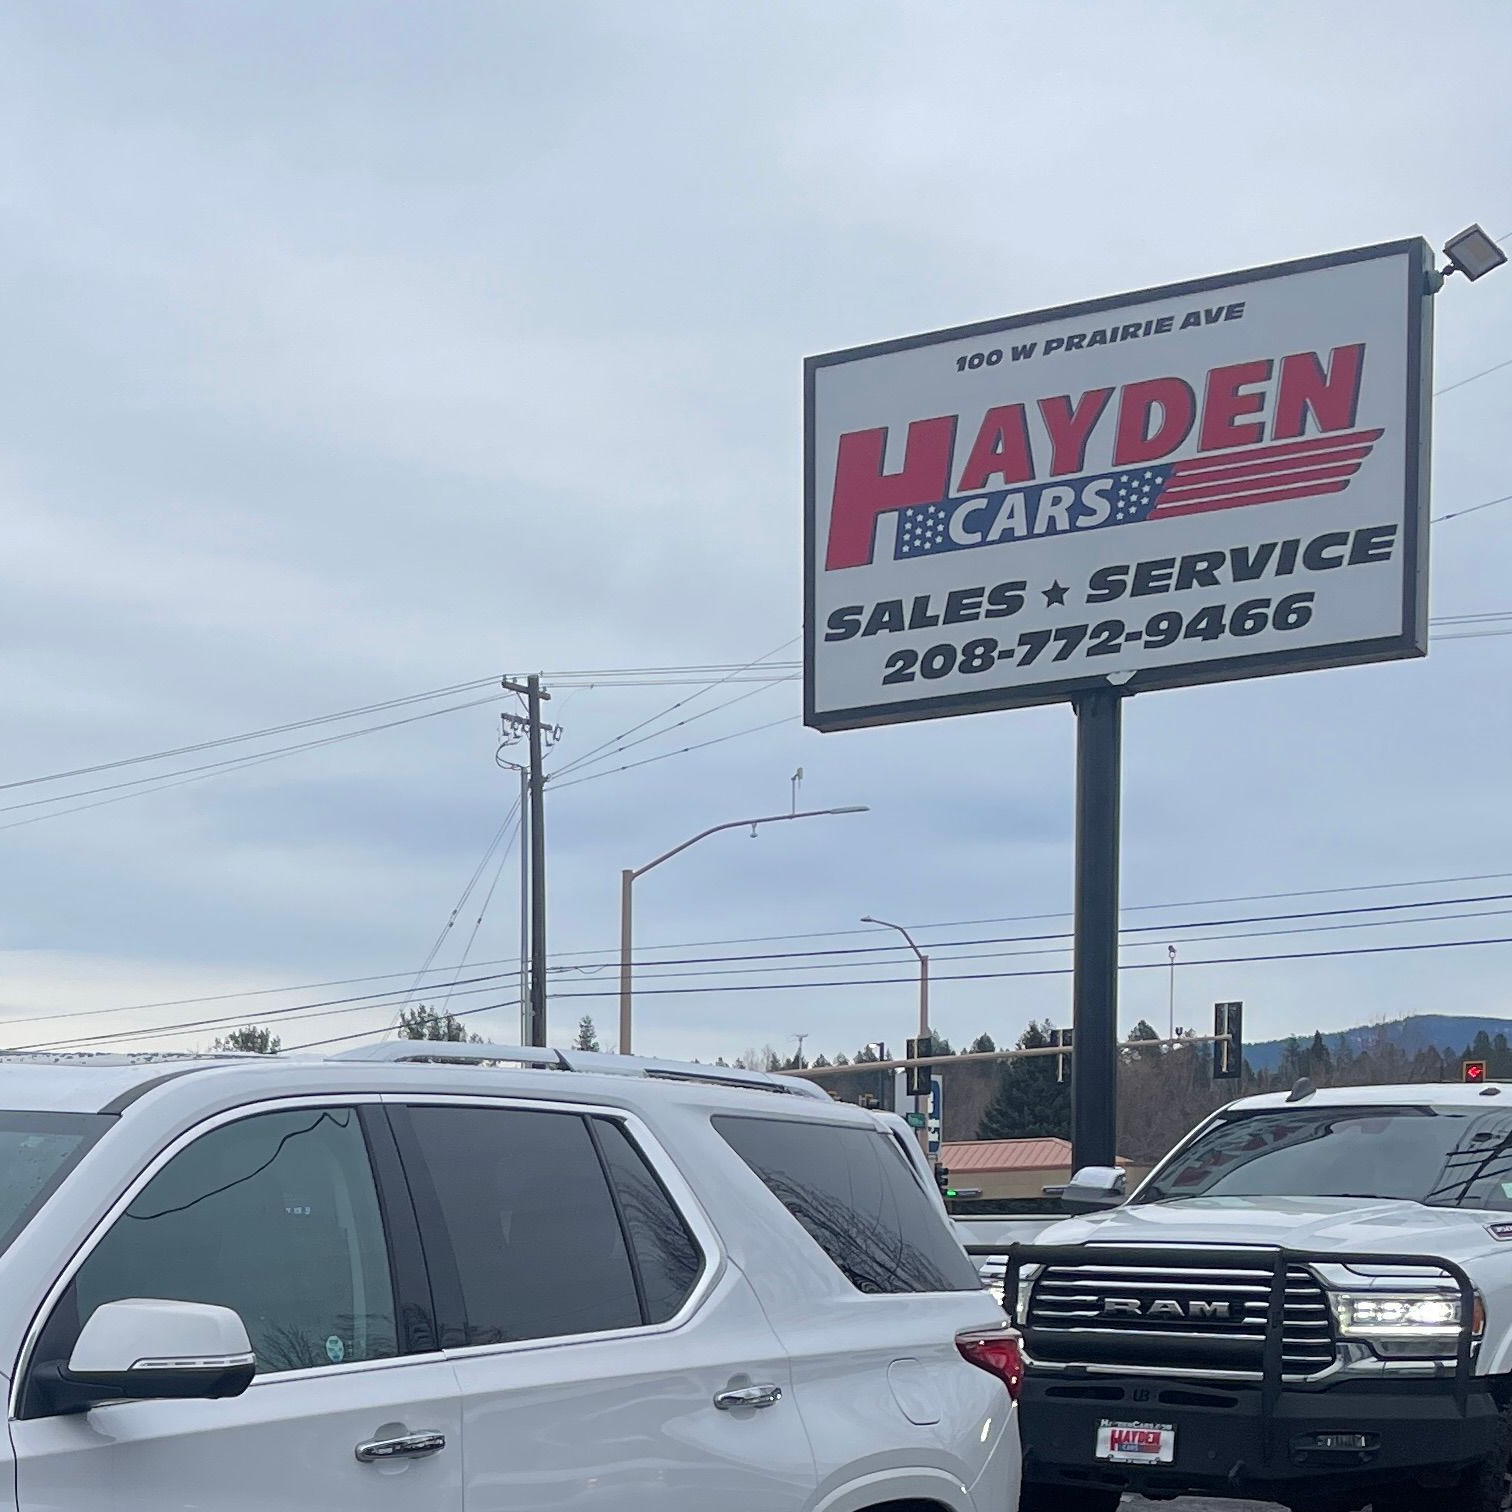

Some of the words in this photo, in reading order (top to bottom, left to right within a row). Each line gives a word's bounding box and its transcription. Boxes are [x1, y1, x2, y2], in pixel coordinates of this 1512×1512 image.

[956, 349, 1003, 372] 100
[1011, 342, 1038, 362] W
[1042, 316, 1176, 357] PRAIRIE
[1179, 301, 1246, 331] AVE
[825, 342, 1366, 571] HAYDEN
[947, 477, 1117, 546] CARS
[824, 580, 1028, 642] SALES
[1086, 524, 1399, 604] SERVICE
[882, 591, 1316, 685] 208-772-9466
[1104, 1298, 1230, 1317] RAM
